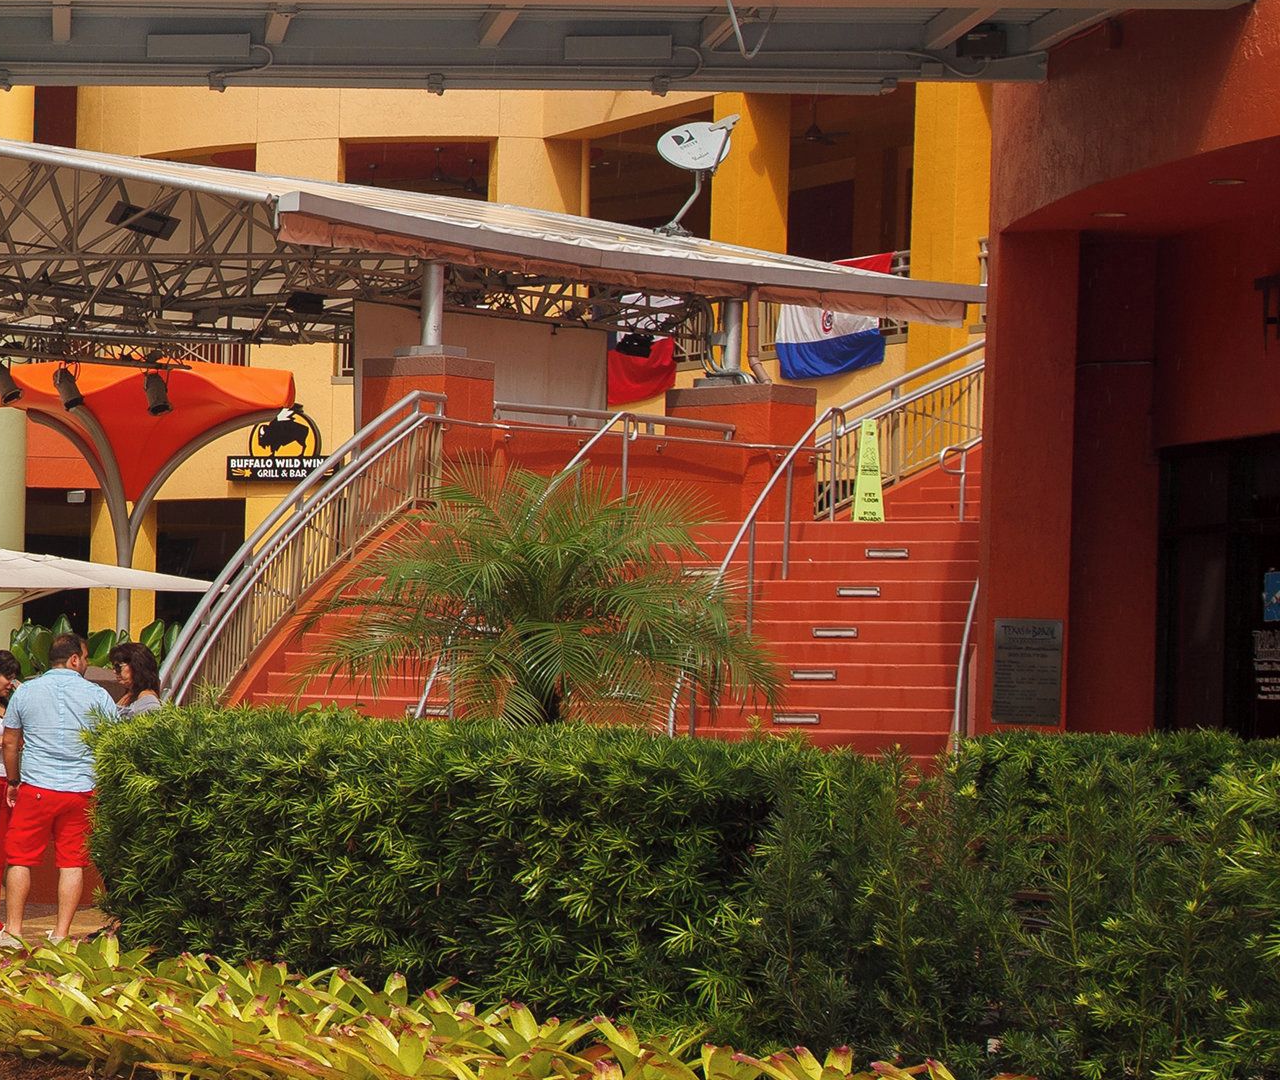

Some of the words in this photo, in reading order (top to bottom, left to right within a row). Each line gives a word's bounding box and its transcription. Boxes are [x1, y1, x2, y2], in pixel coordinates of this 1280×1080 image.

[230, 458, 273, 468] BUFFALO
[275, 458, 301, 468] WILD
[302, 459, 325, 468] WIN
[257, 468, 279, 478] GRILL
[281, 469, 288, 478] &
[290, 469, 307, 478] BAR
